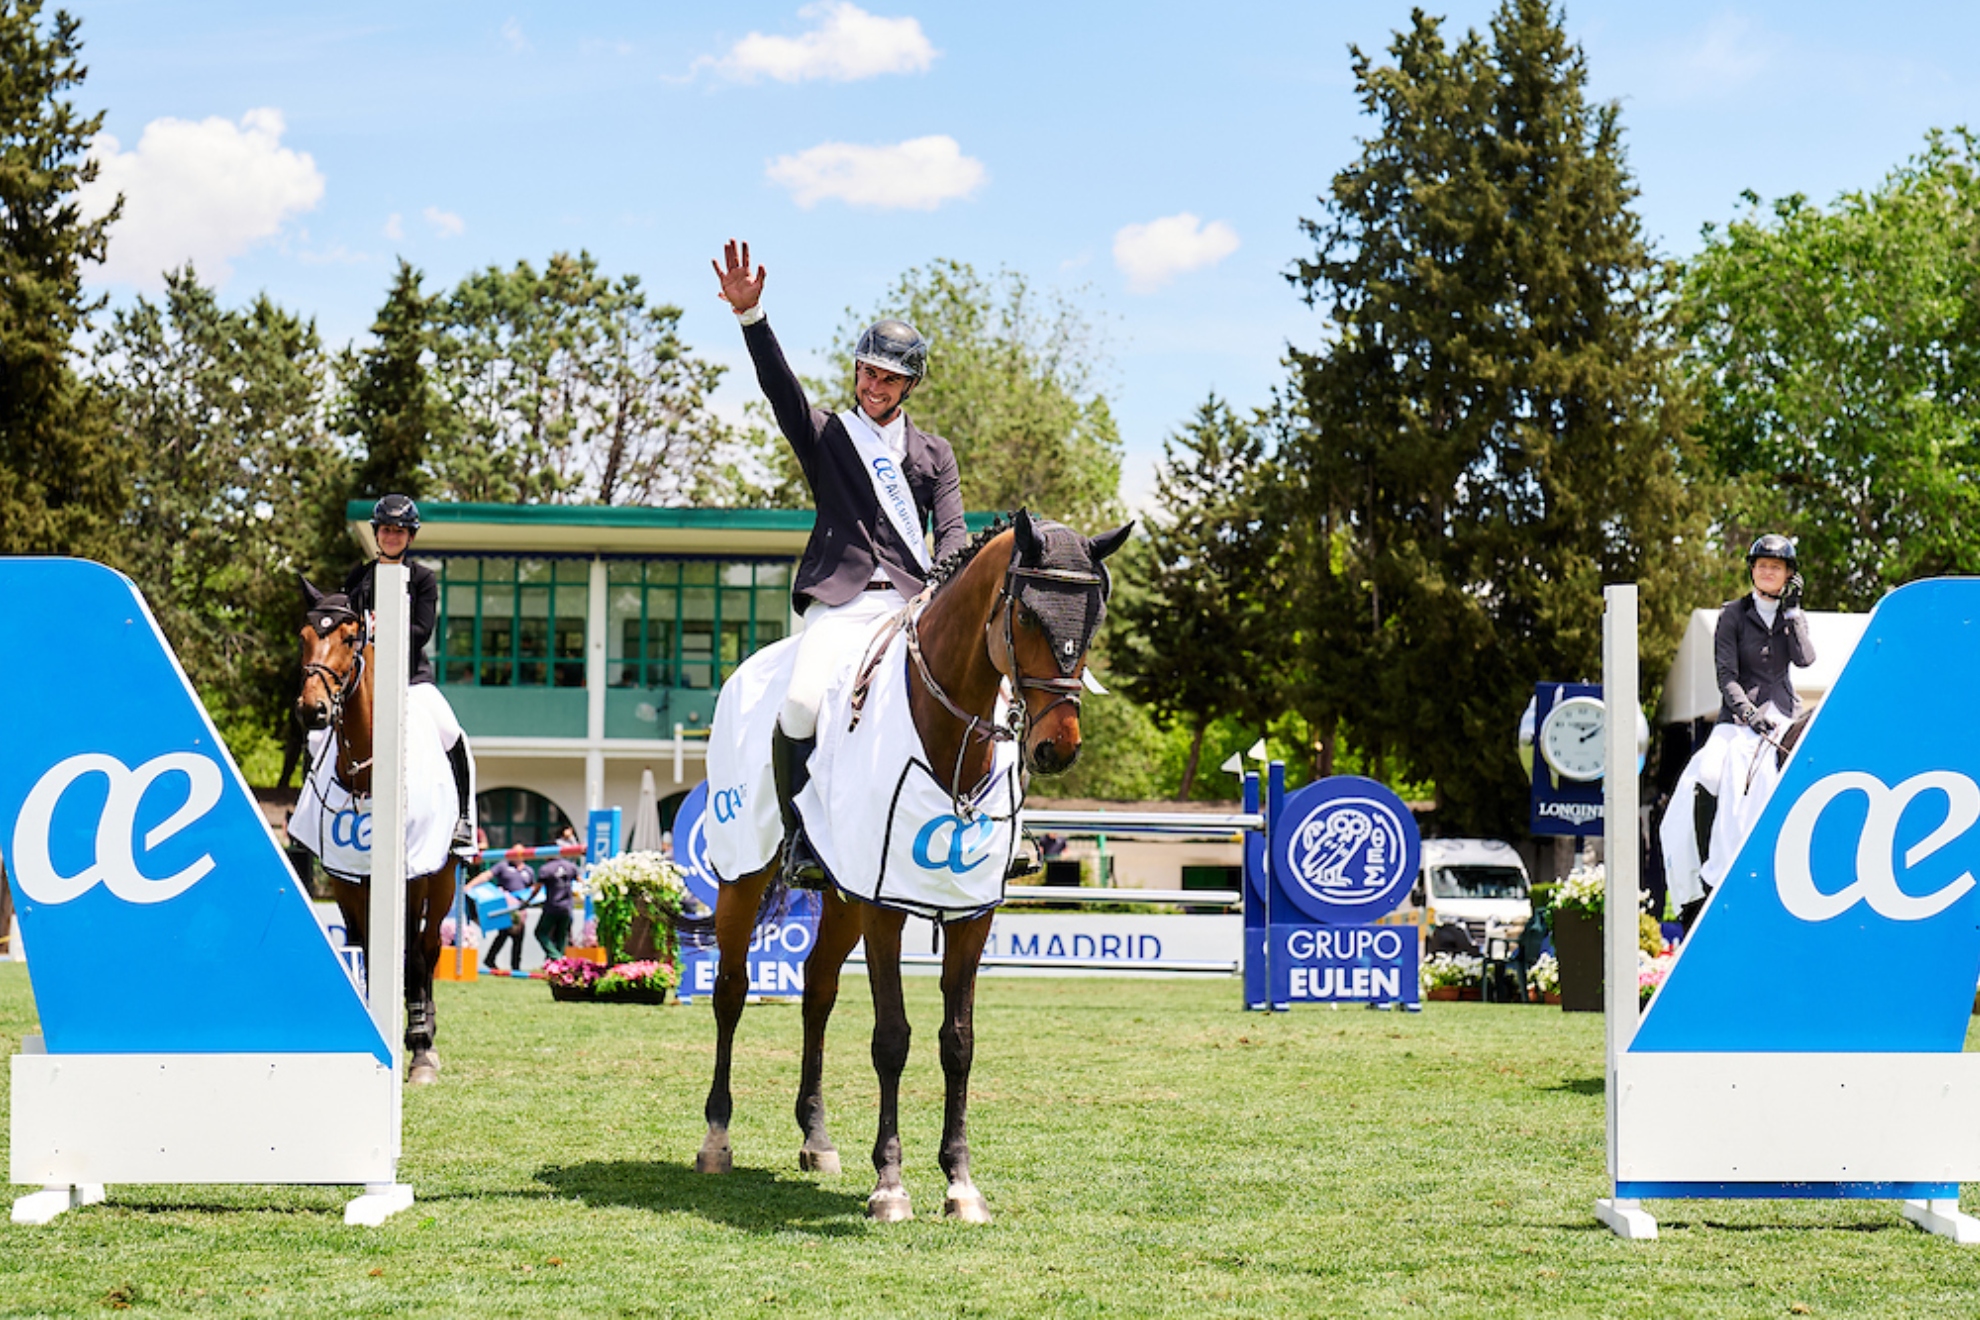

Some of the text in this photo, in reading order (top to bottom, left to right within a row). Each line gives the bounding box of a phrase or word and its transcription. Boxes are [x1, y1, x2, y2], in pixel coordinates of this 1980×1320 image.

[1539, 802, 1605, 818] LONGIN
[1010, 933, 1162, 959] MADRID
[1287, 930, 1401, 960] GRUPO
[694, 960, 806, 992] ELEN
[1289, 967, 1400, 998] EULEN
